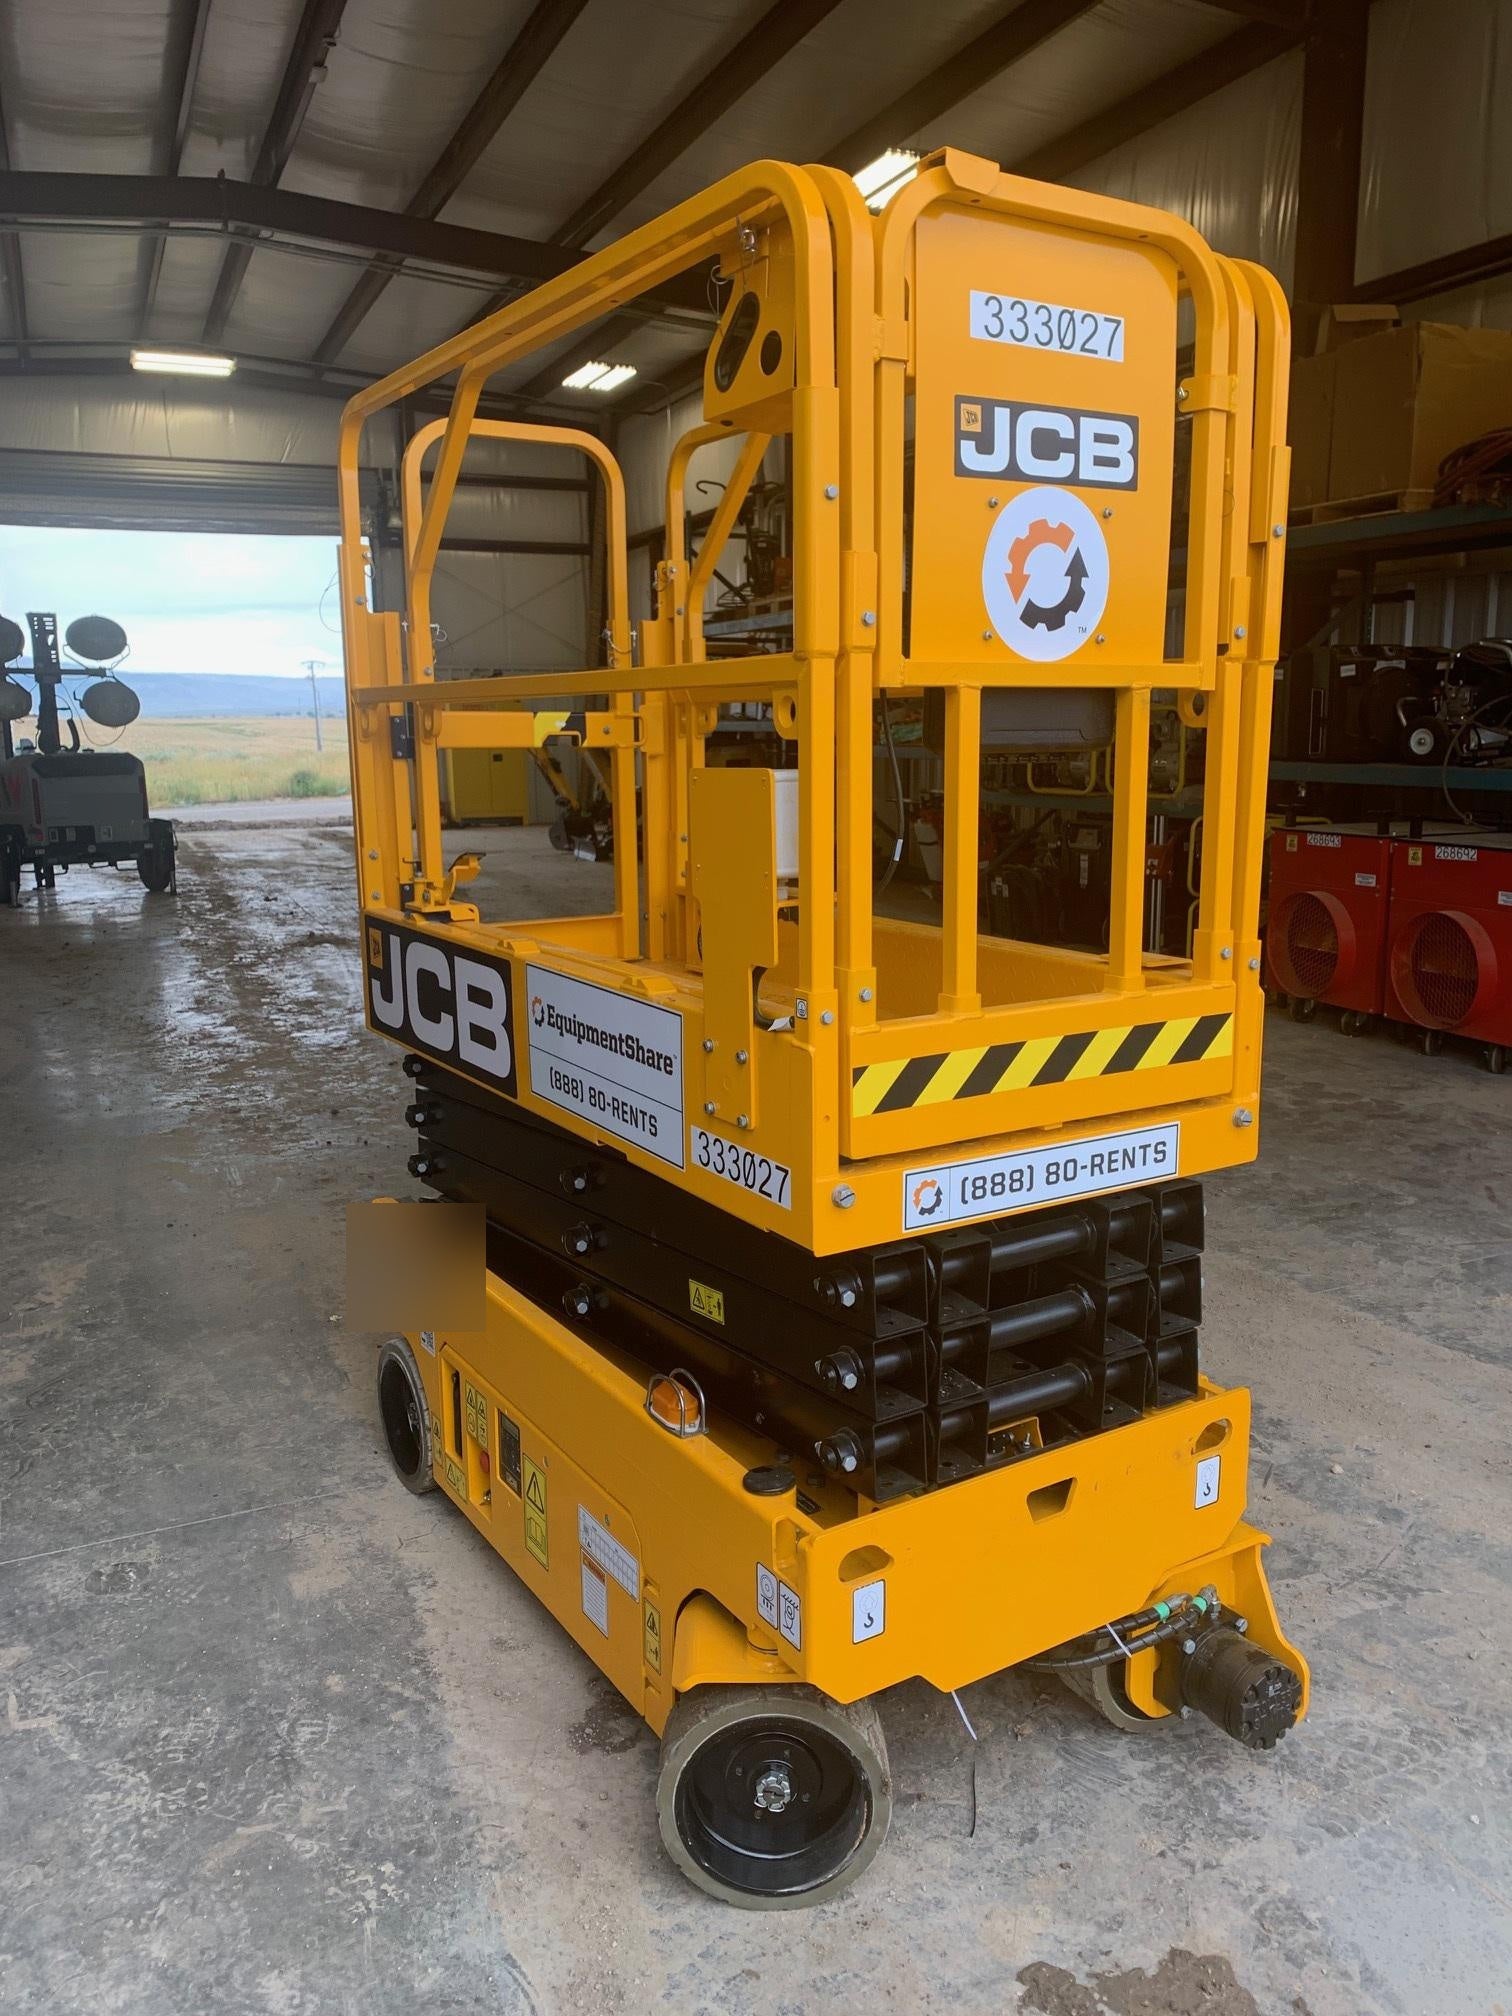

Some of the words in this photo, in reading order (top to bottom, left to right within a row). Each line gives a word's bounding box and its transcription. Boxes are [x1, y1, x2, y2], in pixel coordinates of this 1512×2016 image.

[984, 296, 1121, 357] 333027
[961, 406, 1134, 484] JCB
[1436, 847, 1477, 860] 268692
[371, 934, 511, 1079] JCB
[546, 1005, 673, 1076] EquipmentShare
[549, 1066, 584, 1102] (888)
[589, 1086, 658, 1137] 80-RENTS
[698, 1131, 789, 1203] 333027
[961, 1164, 1034, 1204] (888)
[1045, 1141, 1167, 1186] 80-RENTS
